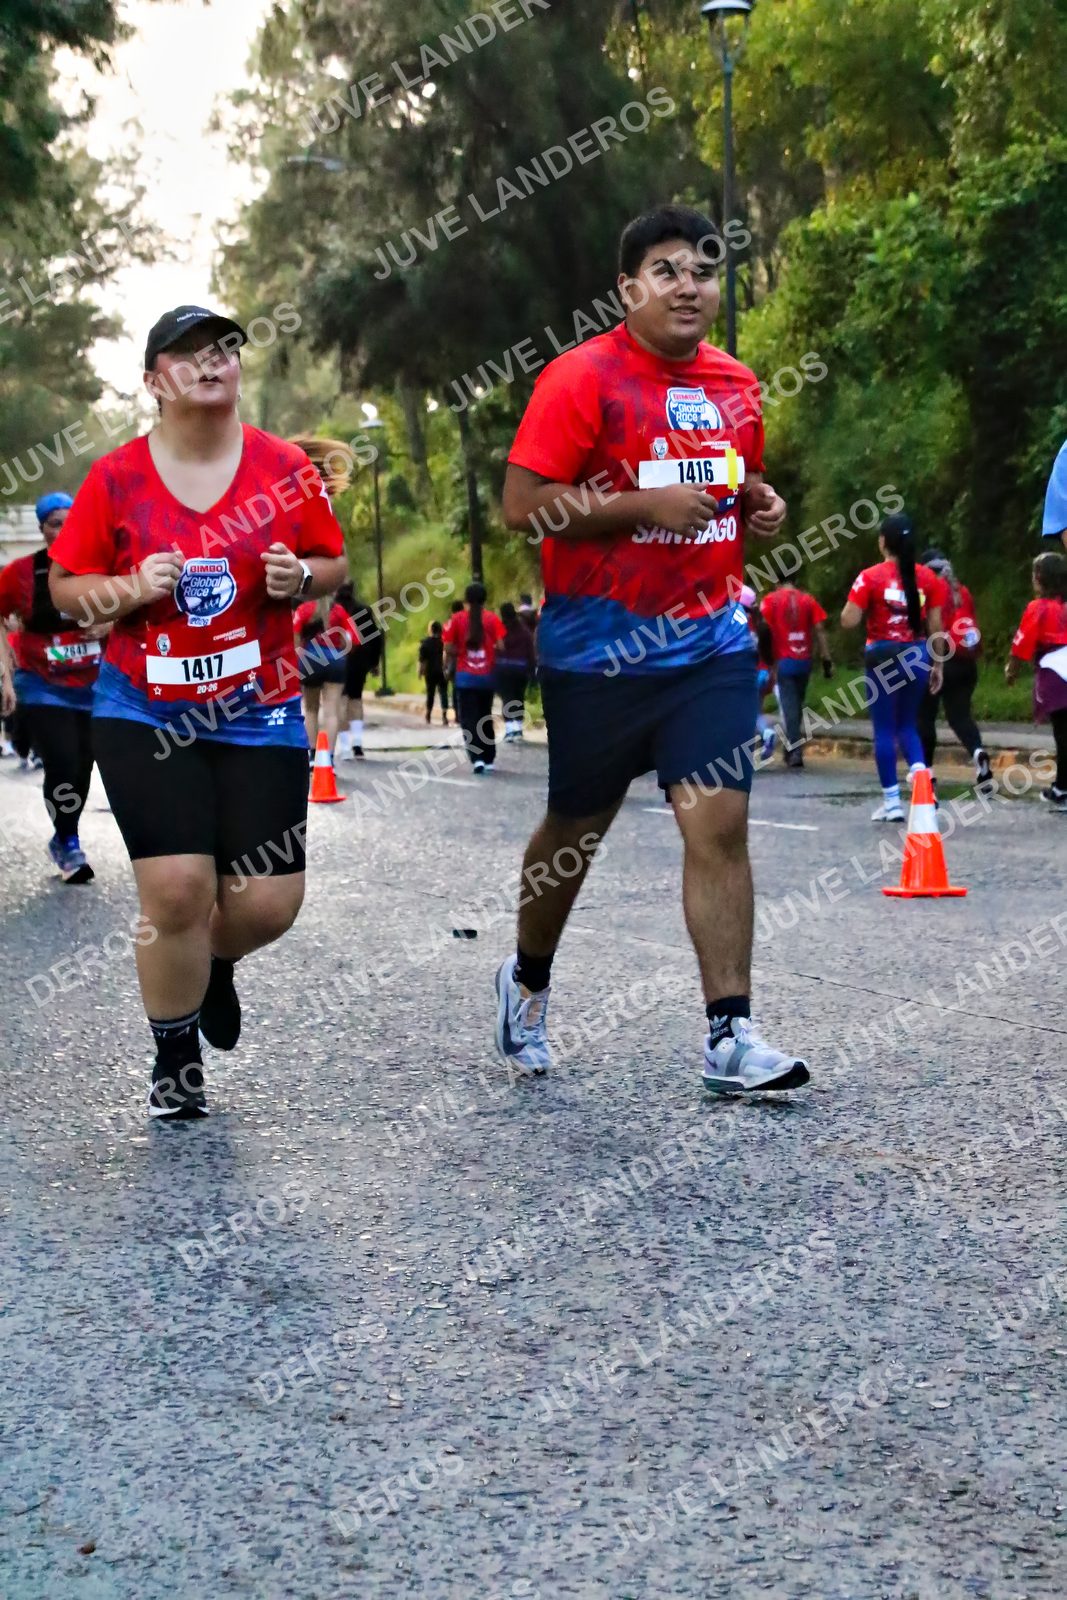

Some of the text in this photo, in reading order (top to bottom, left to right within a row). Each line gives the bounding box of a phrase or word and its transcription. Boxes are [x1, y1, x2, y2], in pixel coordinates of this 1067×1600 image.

[678, 404, 705, 412] Global
[676, 412, 698, 422] Race
[678, 460, 714, 483] 1416
[631, 516, 736, 544] SANAGO
[190, 565, 223, 573] BIMBO
[190, 576, 222, 587] Global
[184, 586, 210, 597] Race
[181, 654, 224, 682] 1417
